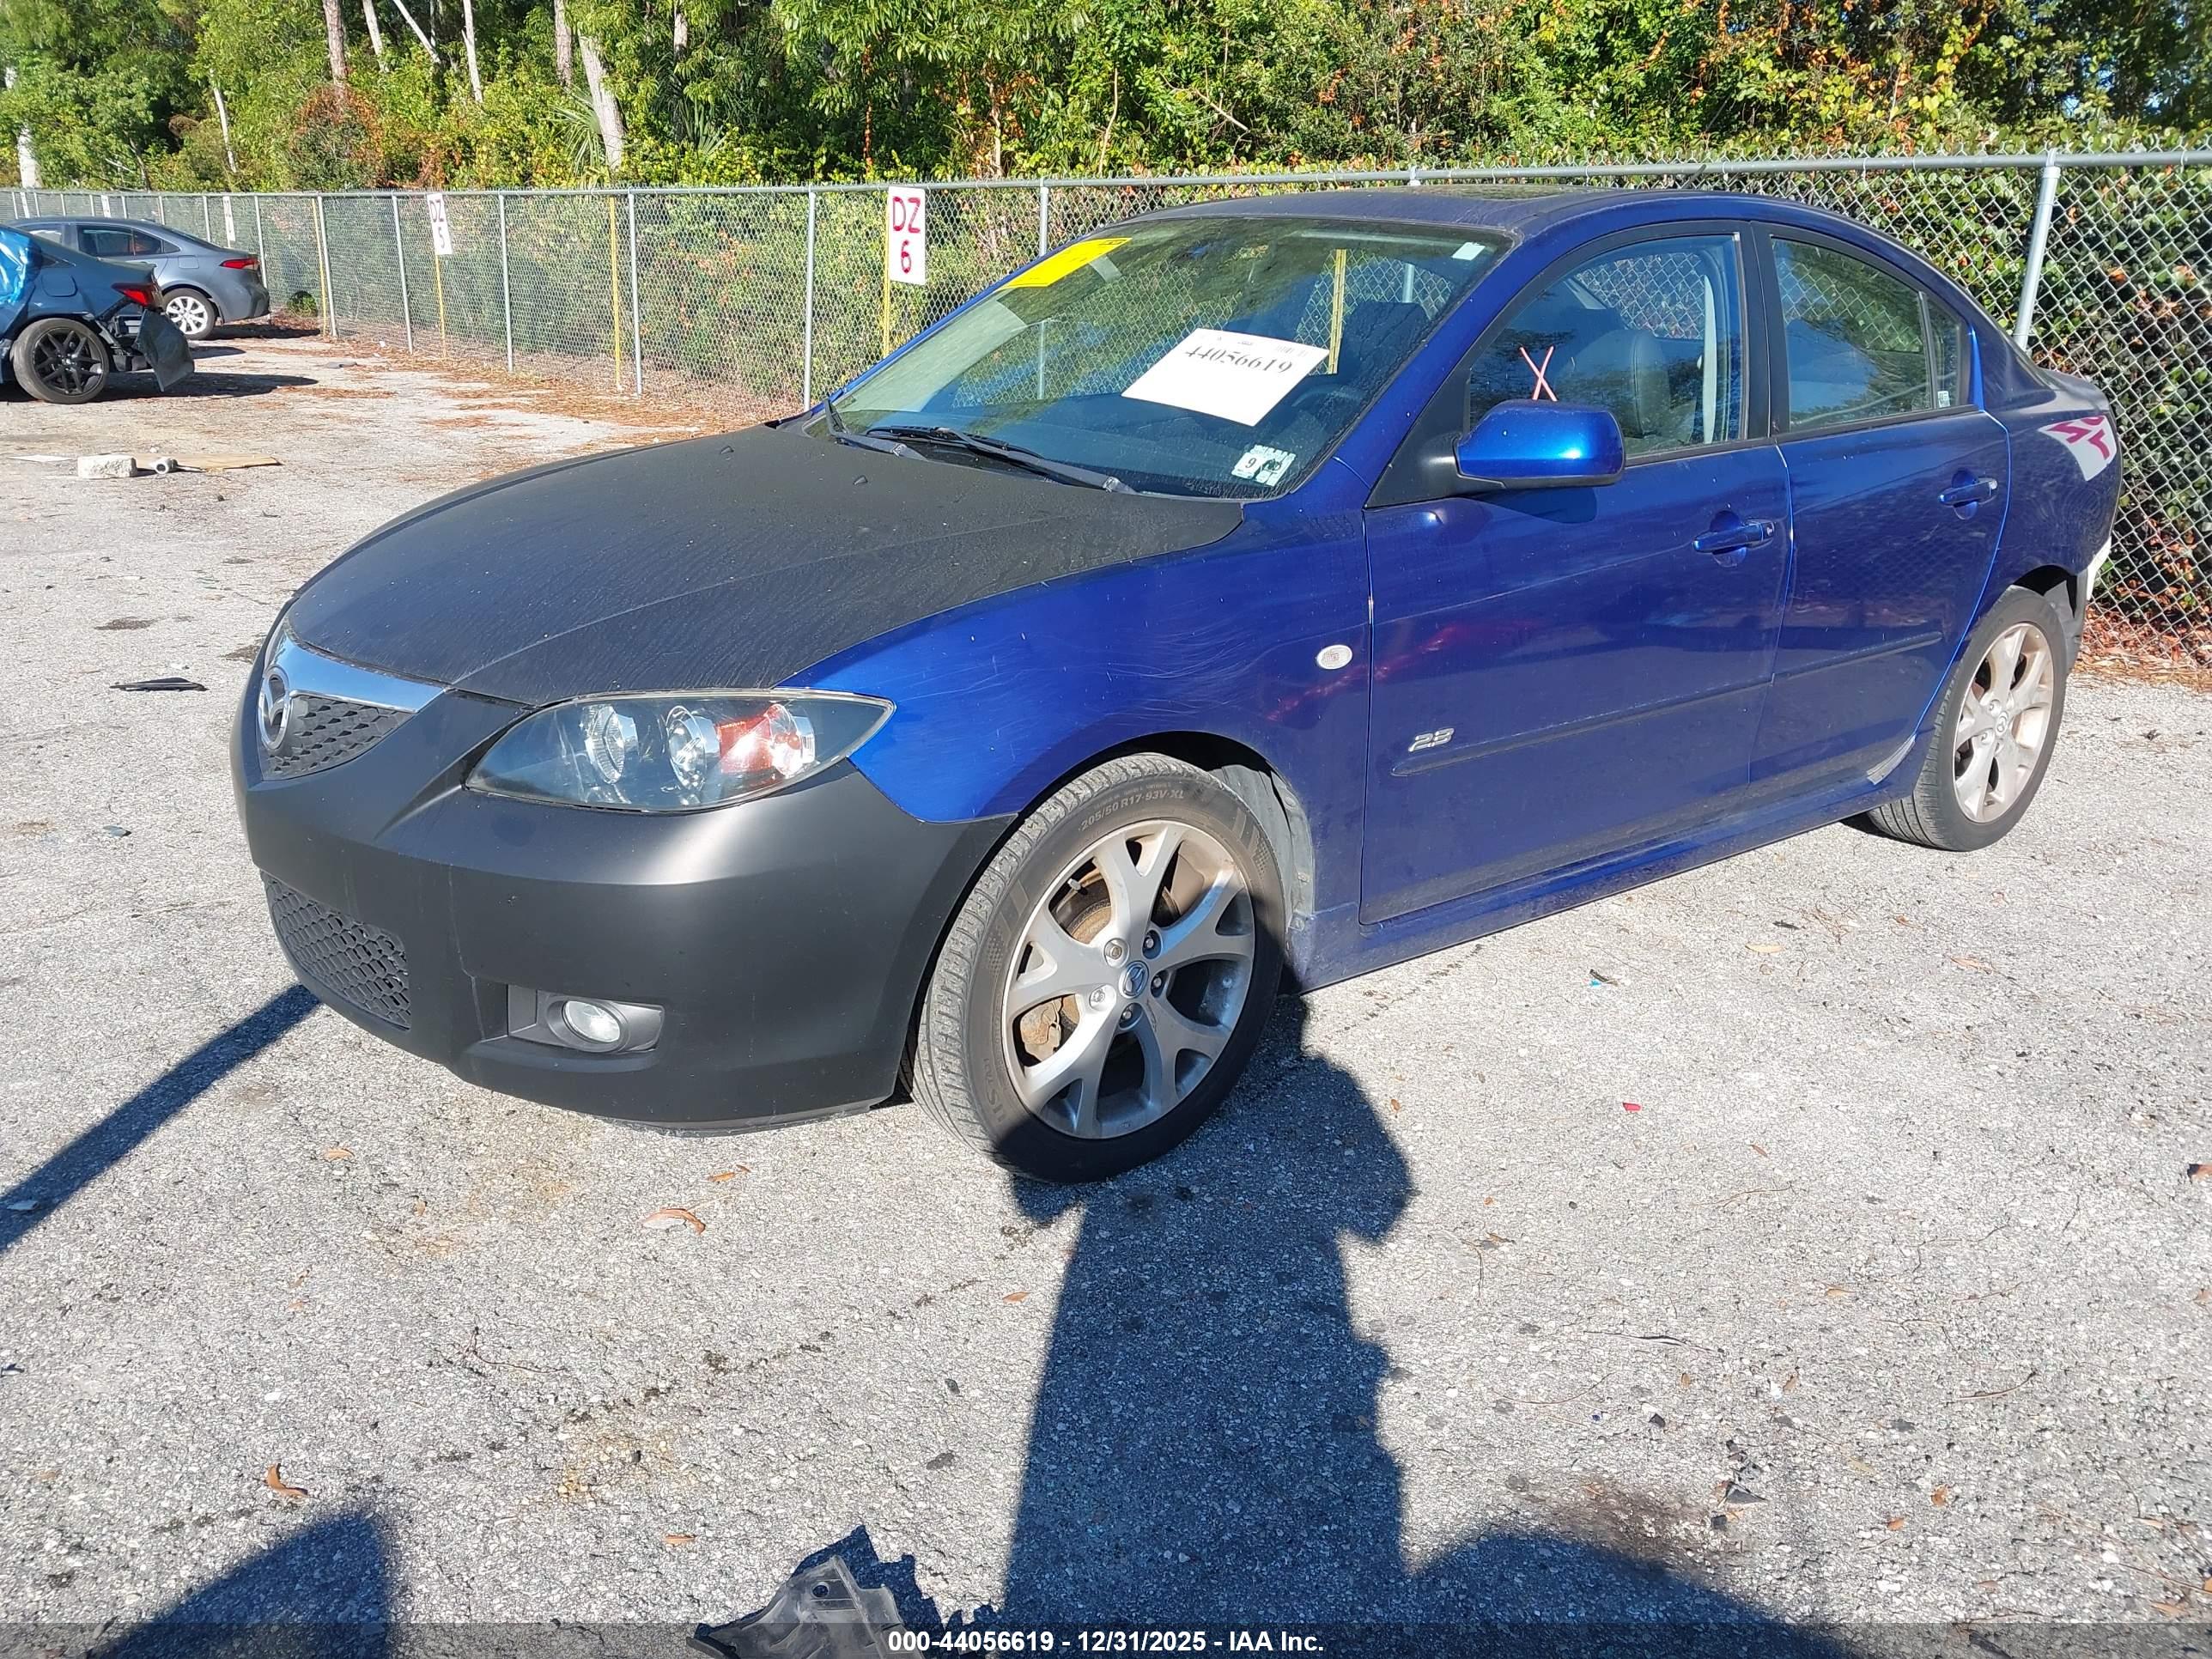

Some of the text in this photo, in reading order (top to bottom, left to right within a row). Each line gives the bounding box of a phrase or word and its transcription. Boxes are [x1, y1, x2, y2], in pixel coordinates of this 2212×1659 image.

[892, 196, 921, 234] DZ
[900, 240, 912, 274] 6
[1185, 345, 1292, 373] 44056619
[1081, 802, 1118, 830] 205/50
